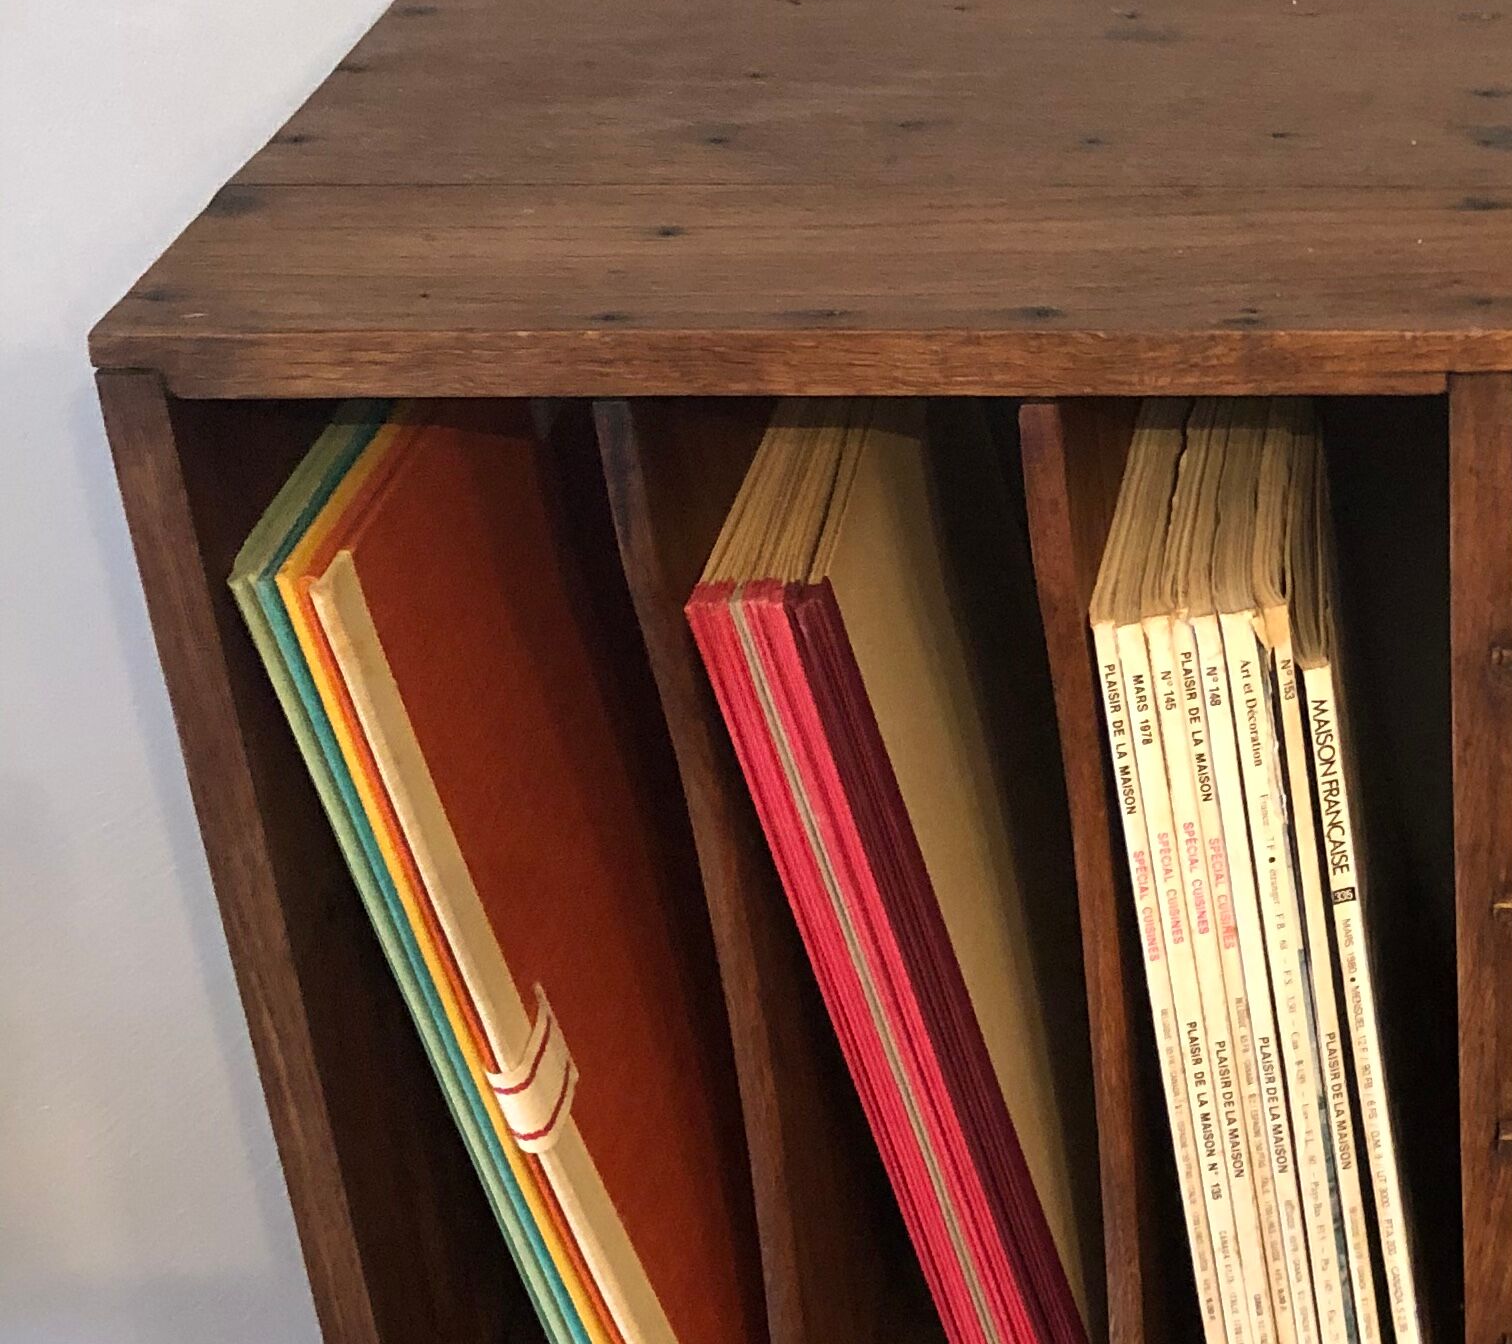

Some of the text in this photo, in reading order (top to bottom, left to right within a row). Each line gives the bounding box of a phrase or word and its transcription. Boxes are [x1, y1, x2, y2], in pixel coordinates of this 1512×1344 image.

[1131, 674, 1153, 745] MARS 1978
[1163, 690, 1176, 710] 145
[1208, 686, 1221, 706] 148
[1238, 658, 1266, 767] Art et Décoration
[1282, 681, 1295, 700] 153
[1103, 663, 1137, 815] PLAISIR DE LA MAISON
[1179, 651, 1211, 801] PLAISIR DE LA MAISON
[1311, 698, 1350, 875] MAISON FRANÇAISE
[1141, 906, 1160, 961] CUISINES
[1165, 888, 1184, 944] CUISINES
[1190, 878, 1209, 934] CUISINES
[1217, 894, 1236, 949] CUISINES
[1341, 918, 1354, 947] MARS
[1349, 985, 1365, 1031] MENSUEL
[1185, 1021, 1202, 1065] PLAISIR
[1193, 1071, 1206, 1086] DE
[1196, 1092, 1209, 1106] LA
[1258, 1036, 1288, 1173] PLAISIR DE LA MAISON
[1324, 1032, 1352, 1169] PLAISIR DE LA MAISON
[1199, 1112, 1217, 1157] MAISON
[1213, 1040, 1245, 1178] PLAISIR DE LA MAISON
